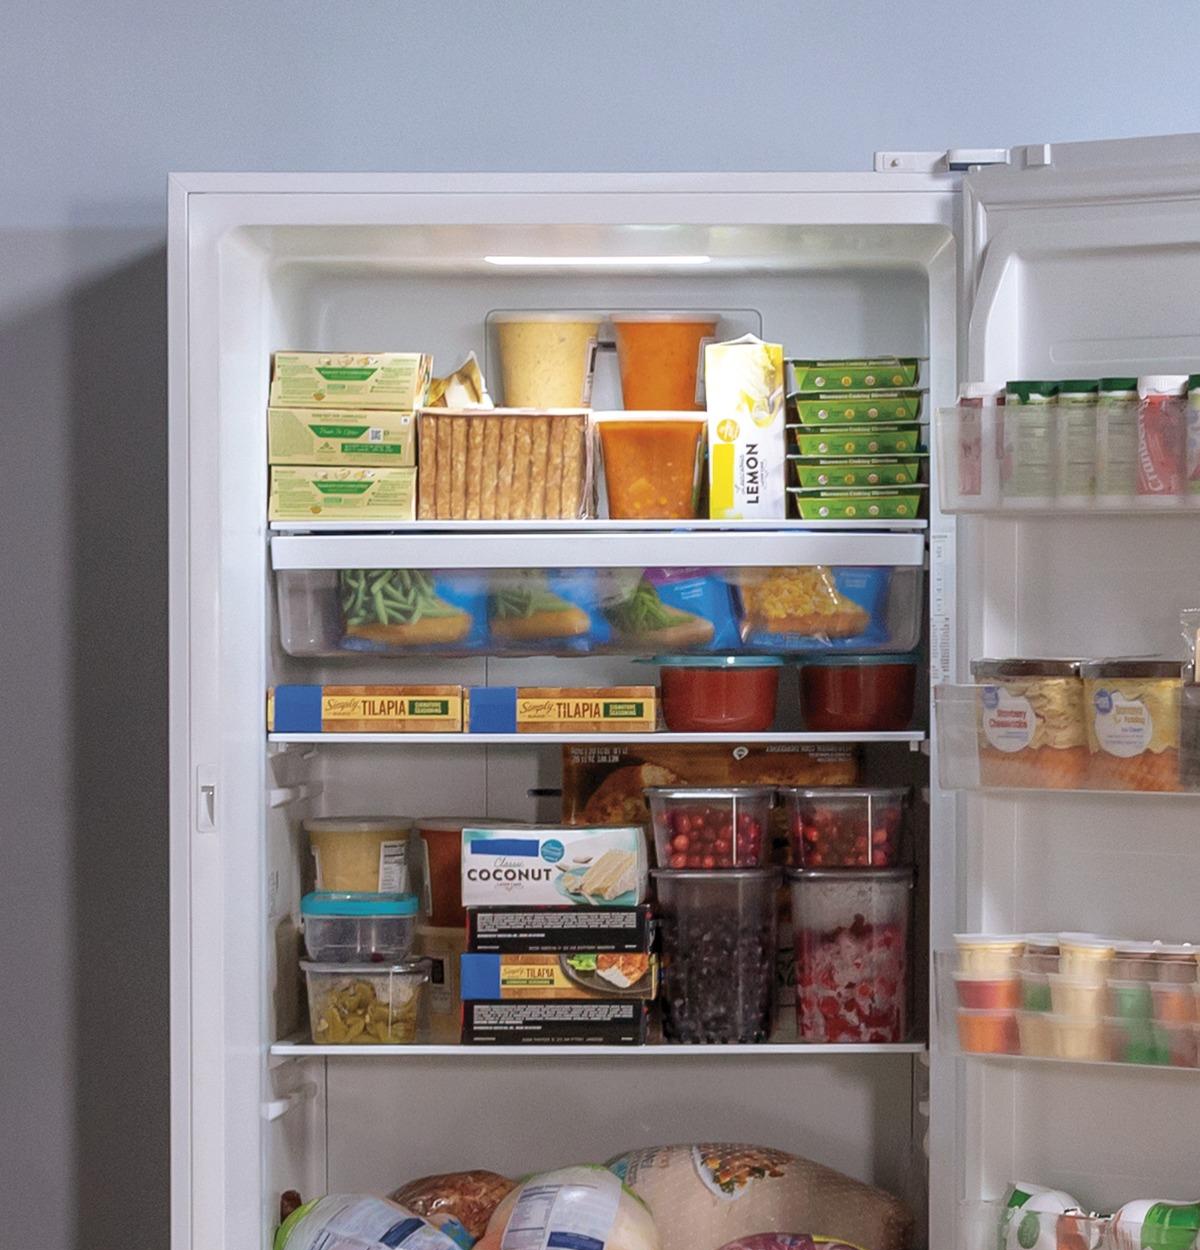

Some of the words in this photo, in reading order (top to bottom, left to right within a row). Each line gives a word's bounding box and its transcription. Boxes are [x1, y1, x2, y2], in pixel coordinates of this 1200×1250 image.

[746, 443, 759, 504] LEMON
[361, 700, 406, 715] TILAPIA
[556, 702, 601, 718] TILAPIA
[467, 868, 552, 881] COCONUT
